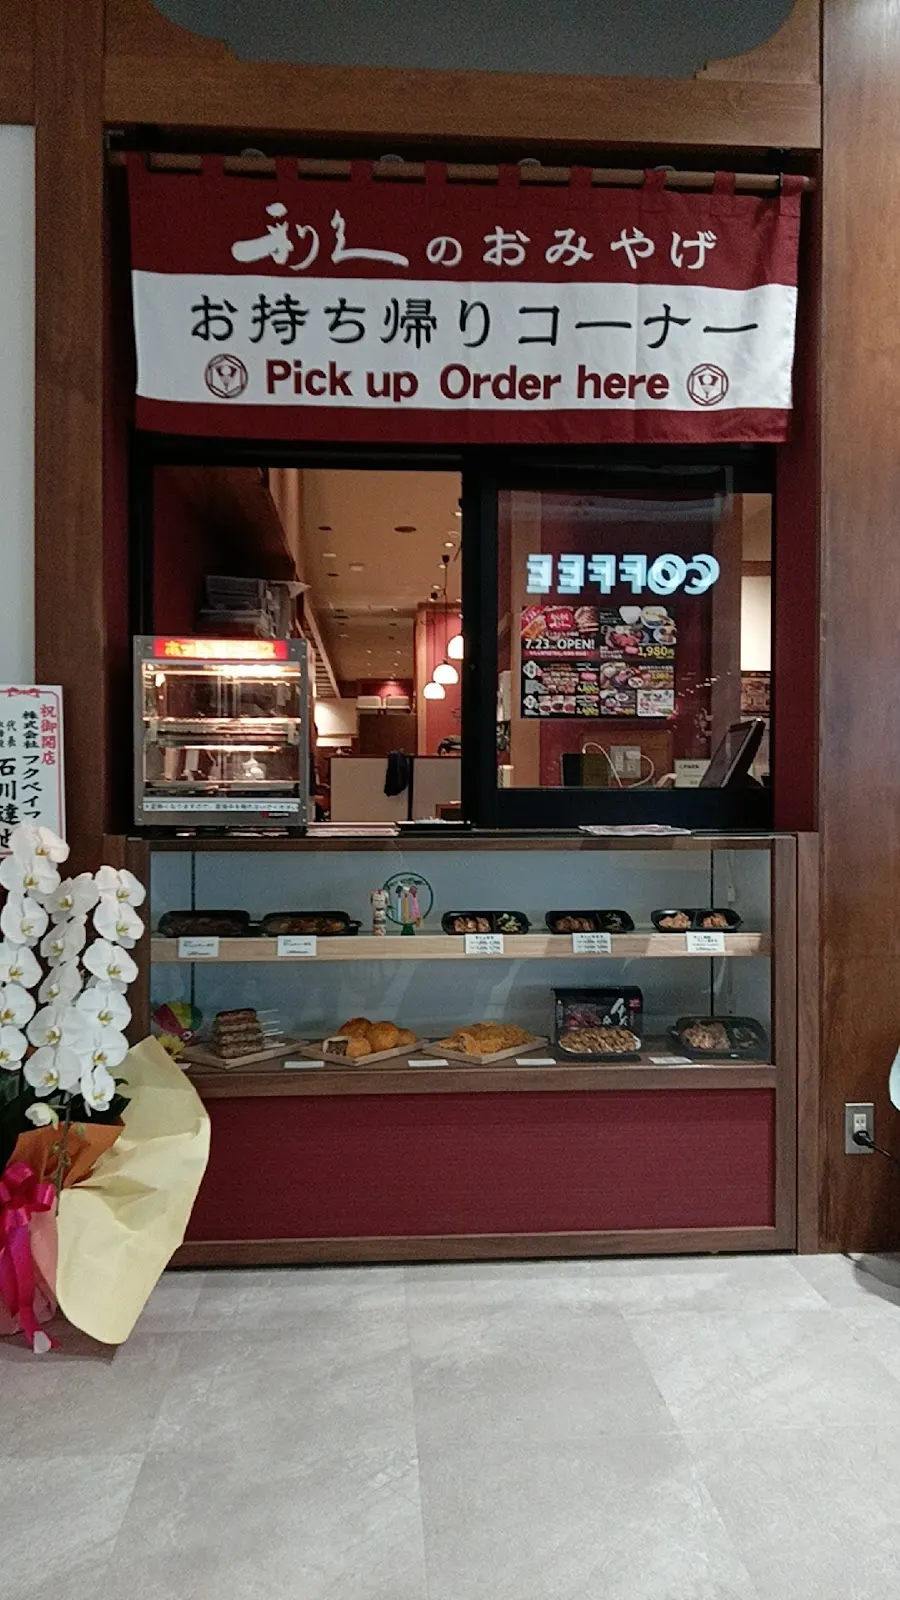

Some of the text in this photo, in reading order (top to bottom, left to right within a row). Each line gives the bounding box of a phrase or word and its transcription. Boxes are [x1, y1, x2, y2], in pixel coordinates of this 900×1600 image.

[191, 293, 759, 349] お持ち帰りコーナー
[265, 358, 670, 402] Pick up Order here
[525, 638, 595, 650] 7.23 OPEN!
